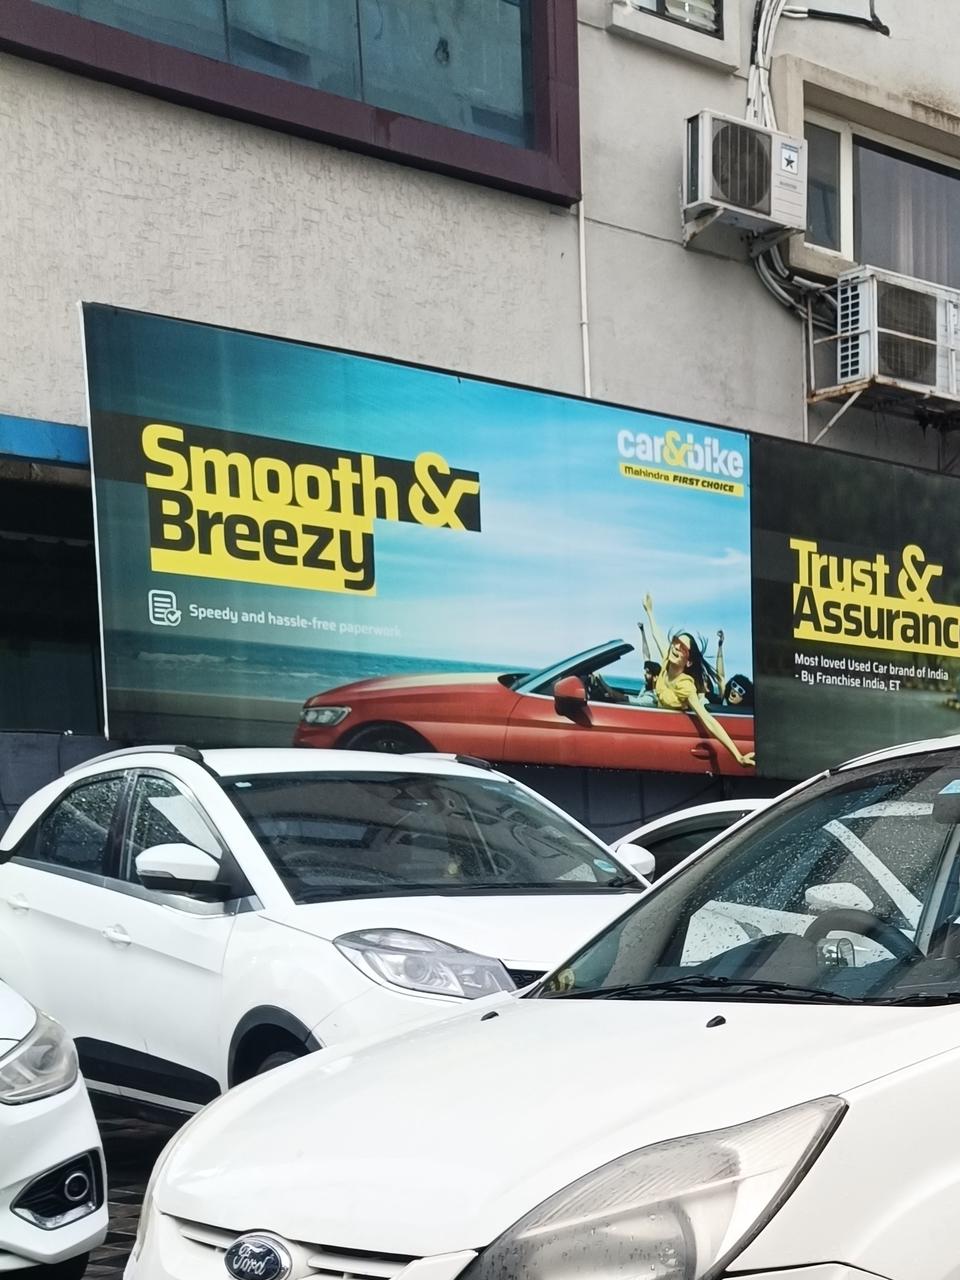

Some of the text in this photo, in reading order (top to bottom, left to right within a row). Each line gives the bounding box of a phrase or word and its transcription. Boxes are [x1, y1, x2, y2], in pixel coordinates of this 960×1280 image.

[617, 429, 744, 478] car&bike
[142, 423, 480, 531] Smooth &
[624, 466, 735, 493] Mahindra FIRST CHOICE
[150, 489, 376, 591] Breezy
[790, 537, 943, 604] Trust &
[188, 604, 238, 624] Speedy
[241, 611, 265, 625] and
[268, 614, 336, 632] hassle-free
[794, 652, 949, 681] Most loved Used Car brand of India
[801, 670, 815, 685] By
[816, 671, 861, 688] Franchise
[862, 677, 888, 692] India,
[889, 680, 901, 691] ET
[232, 1242, 273, 1276] Ford
